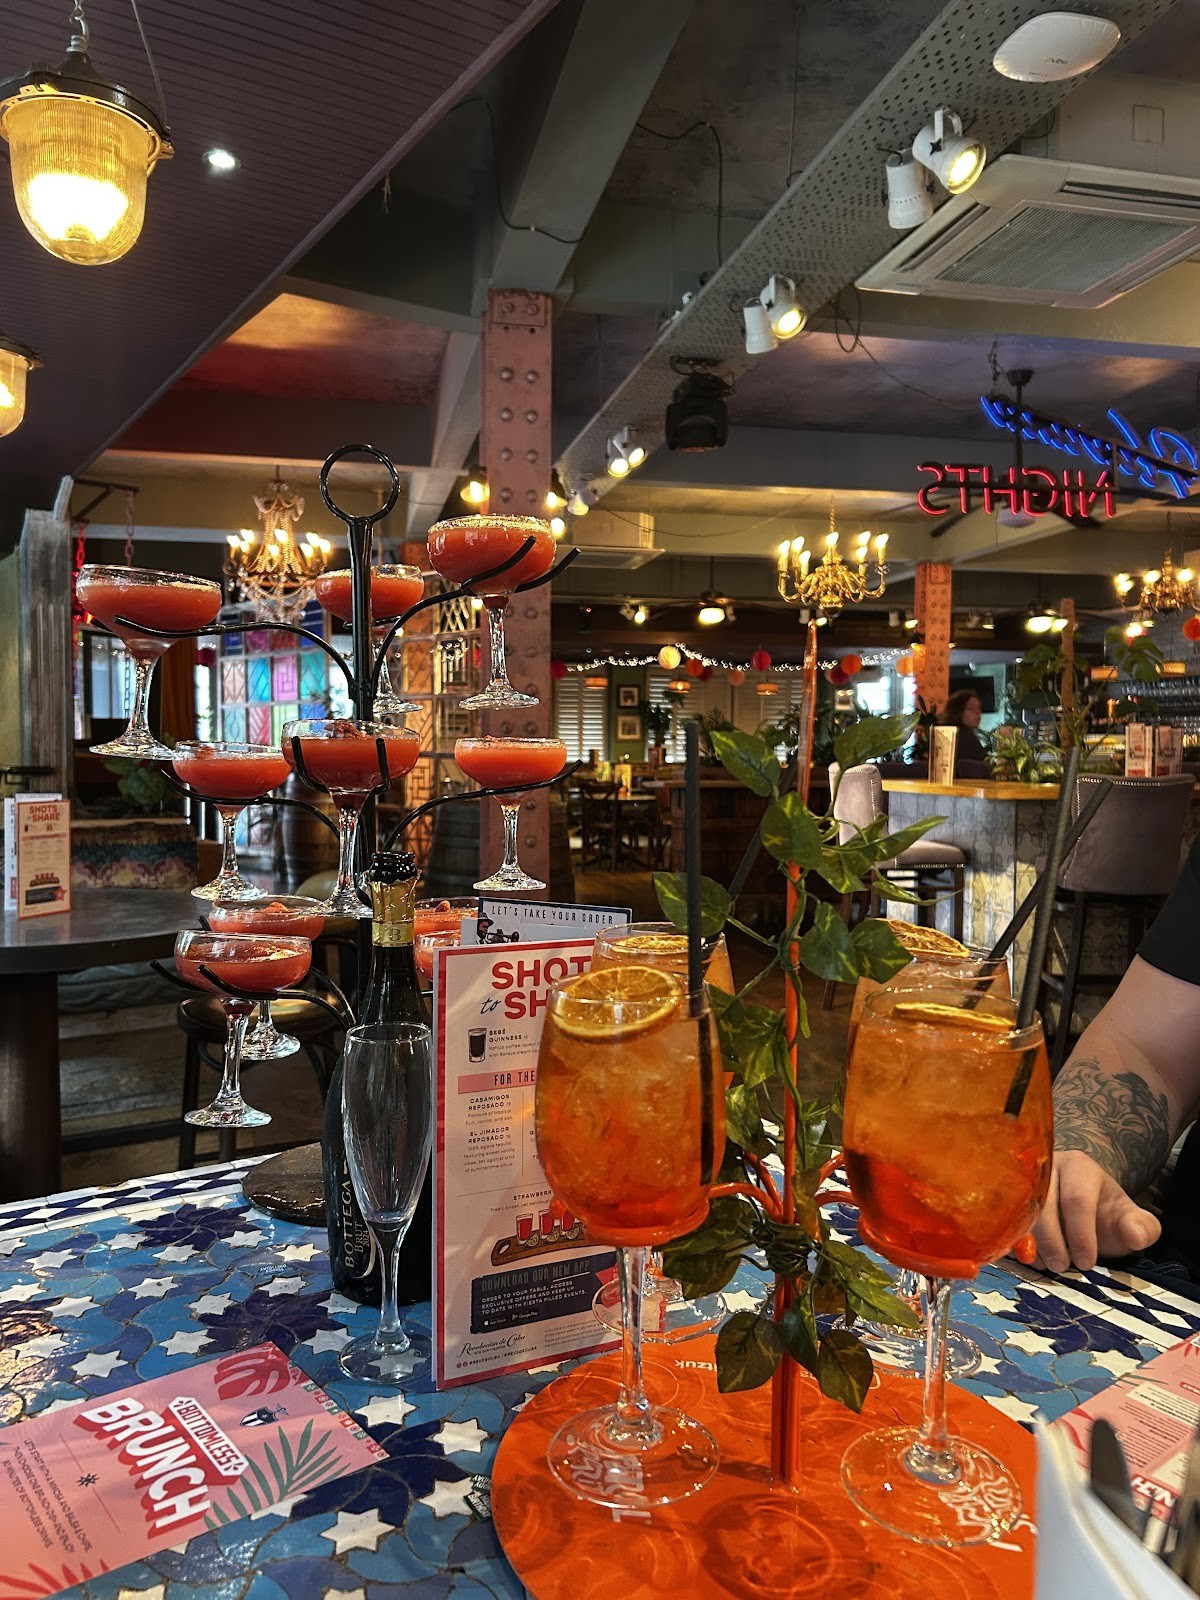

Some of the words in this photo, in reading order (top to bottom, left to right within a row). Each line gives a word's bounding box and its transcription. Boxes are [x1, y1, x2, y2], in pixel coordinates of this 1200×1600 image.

[29, 804, 57, 814] SHOTS
[32, 812, 60, 822] SHARE
[492, 905, 518, 916] LET'S
[524, 908, 546, 919] TAKE
[552, 910, 576, 922] YOUR
[582, 912, 613, 924] ORDER
[492, 956, 592, 990] SHOT
[480, 998, 502, 1014] to
[494, 1073, 512, 1086] FOR
[518, 1070, 535, 1083] THE
[468, 1102, 504, 1110] REPOSADO
[470, 1094, 510, 1104] CASAMIGOS
[480, 1126, 510, 1135] JIMADOR
[468, 1134, 504, 1143] REPOSADO
[513, 1190, 552, 1200] STRAWBERR
[342, 1180, 354, 1268] BOTTEGA
[354, 1221, 364, 1253] BRUT
[482, 1272, 529, 1291] DOWNLOAD
[532, 1268, 549, 1281] OUR
[552, 1264, 570, 1277] NEW
[574, 1260, 590, 1273] APP
[482, 1293, 502, 1303] ORDER
[550, 1280, 573, 1289] ACCESS
[482, 1299, 513, 1309] EXCLUSIVE
[515, 1294, 537, 1302] OFFERS
[523, 1298, 543, 1306] FIESTA
[675, 1360, 717, 1371] itzuk
[178, 1404, 240, 1468] BOTTOMLESS
[80, 1397, 211, 1530] BRUNCH
